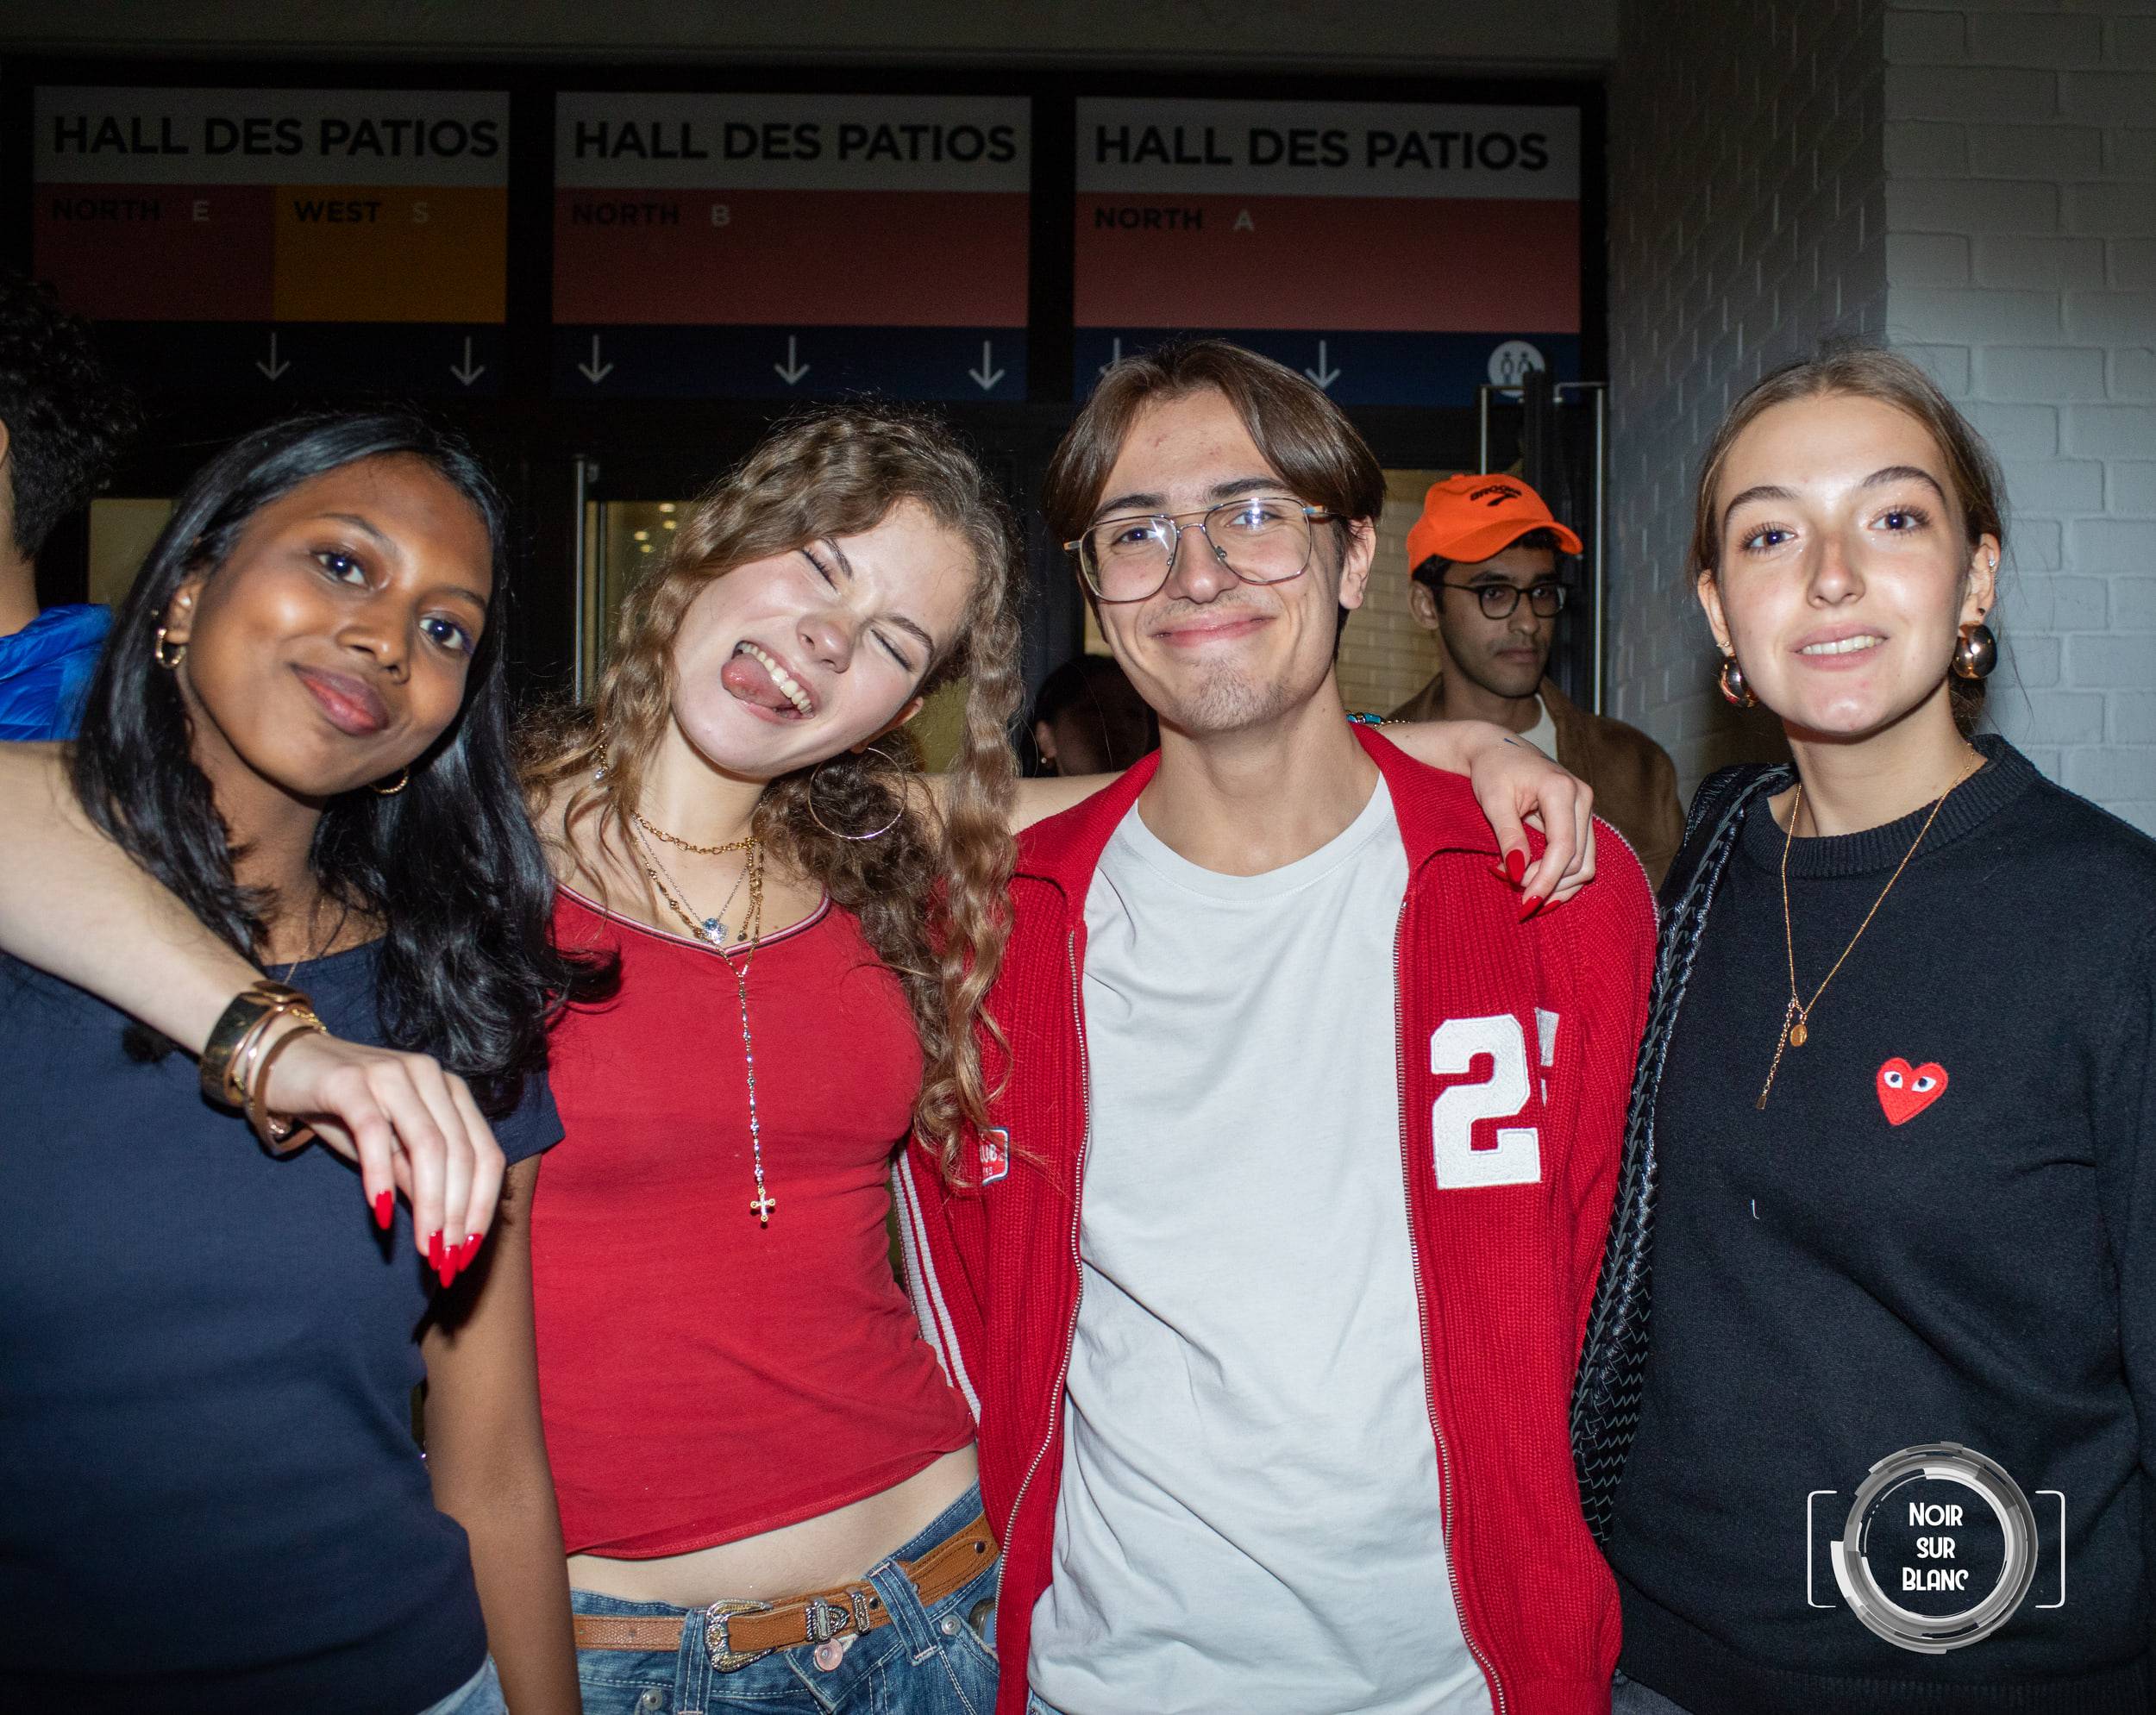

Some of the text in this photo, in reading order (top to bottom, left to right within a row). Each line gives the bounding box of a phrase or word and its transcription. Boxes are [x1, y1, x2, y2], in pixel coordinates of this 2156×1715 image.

[53, 116, 499, 157] HALL DES PATIOS
[575, 122, 1016, 162] HALL DES PATIOS
[1095, 126, 1549, 171] HALL DES PATIOS
[52, 199, 210, 222] NORTH E
[293, 200, 429, 222] WEST S
[572, 203, 731, 228] NORTH B
[1094, 206, 1255, 232] NORTH A
